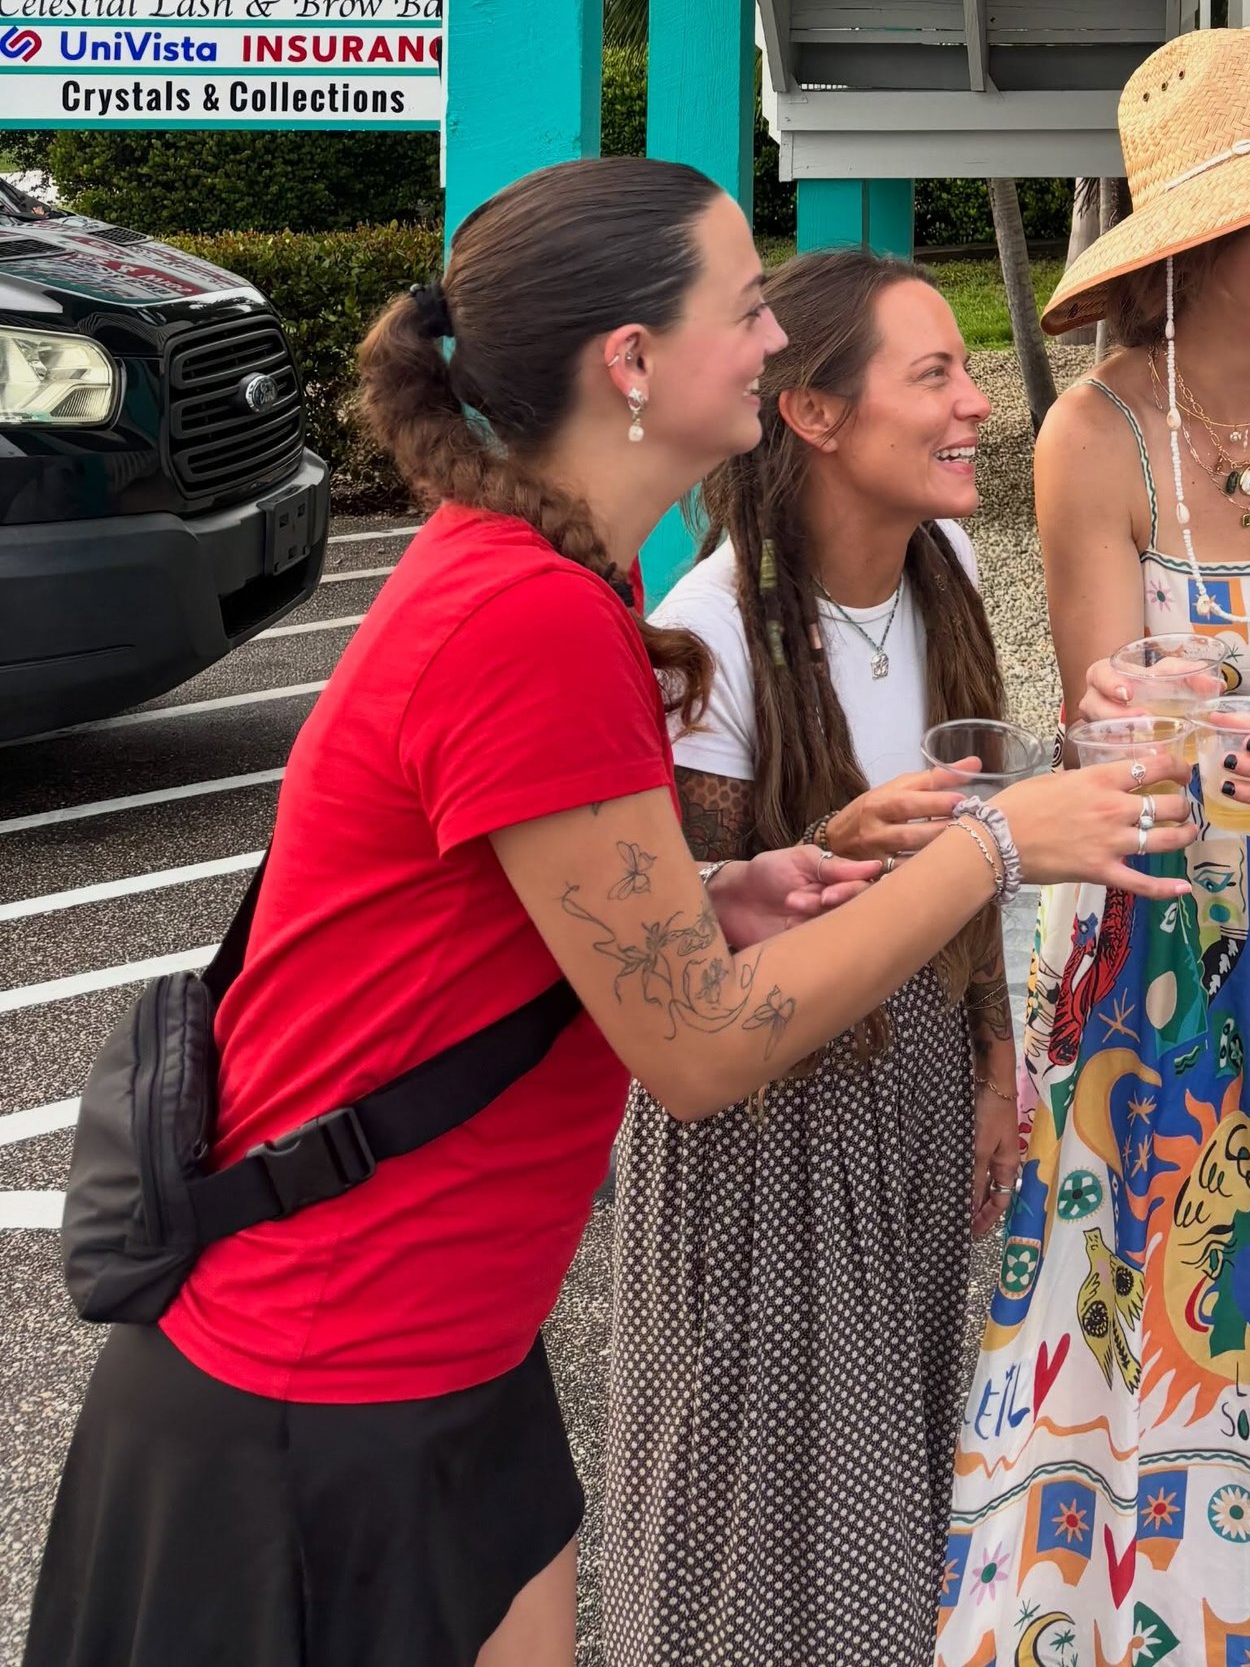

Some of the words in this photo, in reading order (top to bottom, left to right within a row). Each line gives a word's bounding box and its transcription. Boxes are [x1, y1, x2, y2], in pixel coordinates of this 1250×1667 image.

[60, 31, 218, 64] UniVista
[62, 80, 192, 117] Crystals
[202, 82, 220, 113] &
[229, 81, 406, 115] Collections
